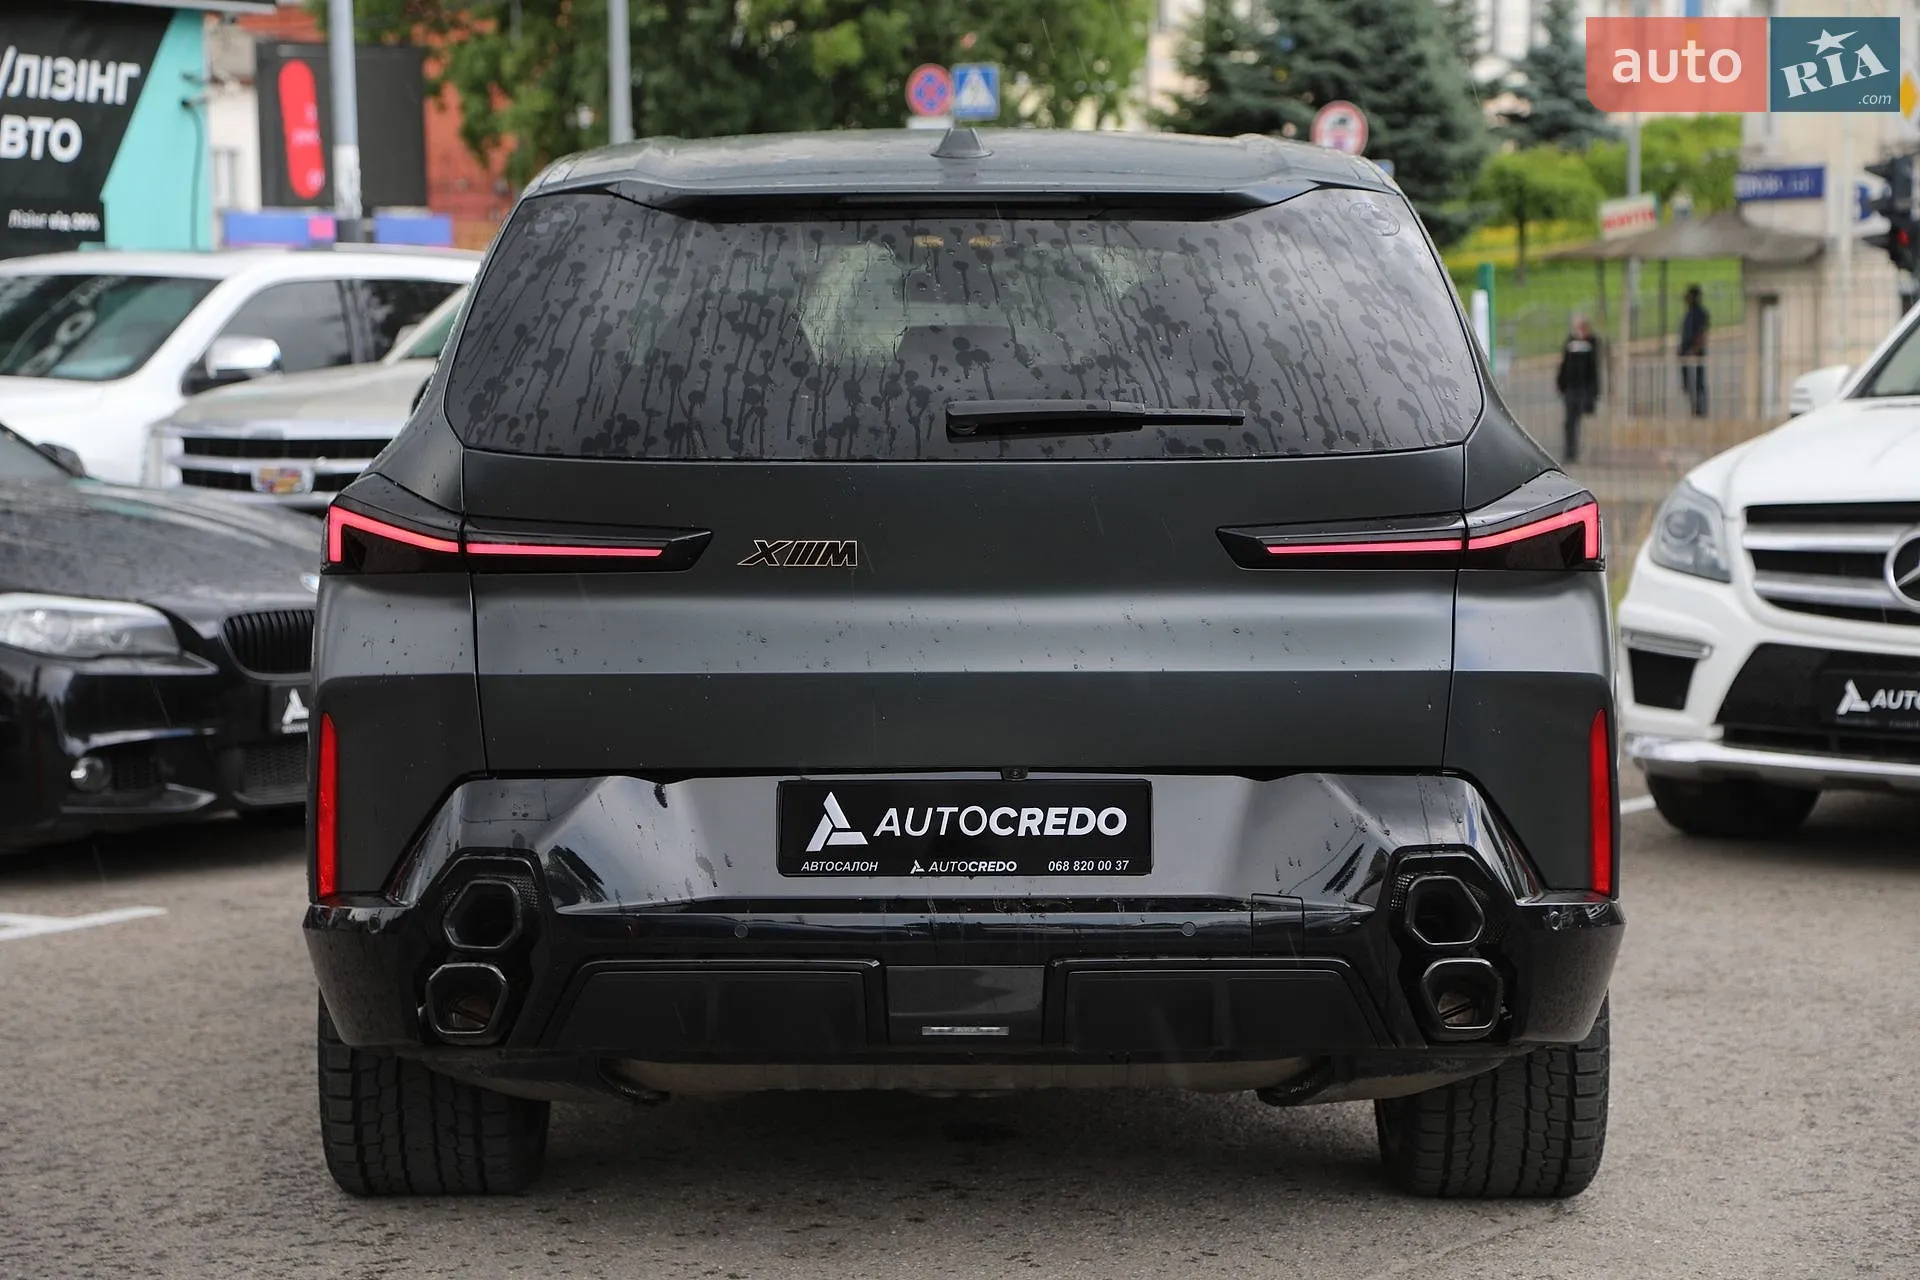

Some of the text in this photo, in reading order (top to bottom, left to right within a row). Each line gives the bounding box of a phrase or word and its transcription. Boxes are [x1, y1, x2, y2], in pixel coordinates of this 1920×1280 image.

[872, 805, 1127, 837] AUTOCREDO
[800, 861, 879, 873] АВТОСАЛОН
[928, 860, 1018, 873] AUTOCREDO
[1048, 860, 1130, 872] 068 820 00 37
